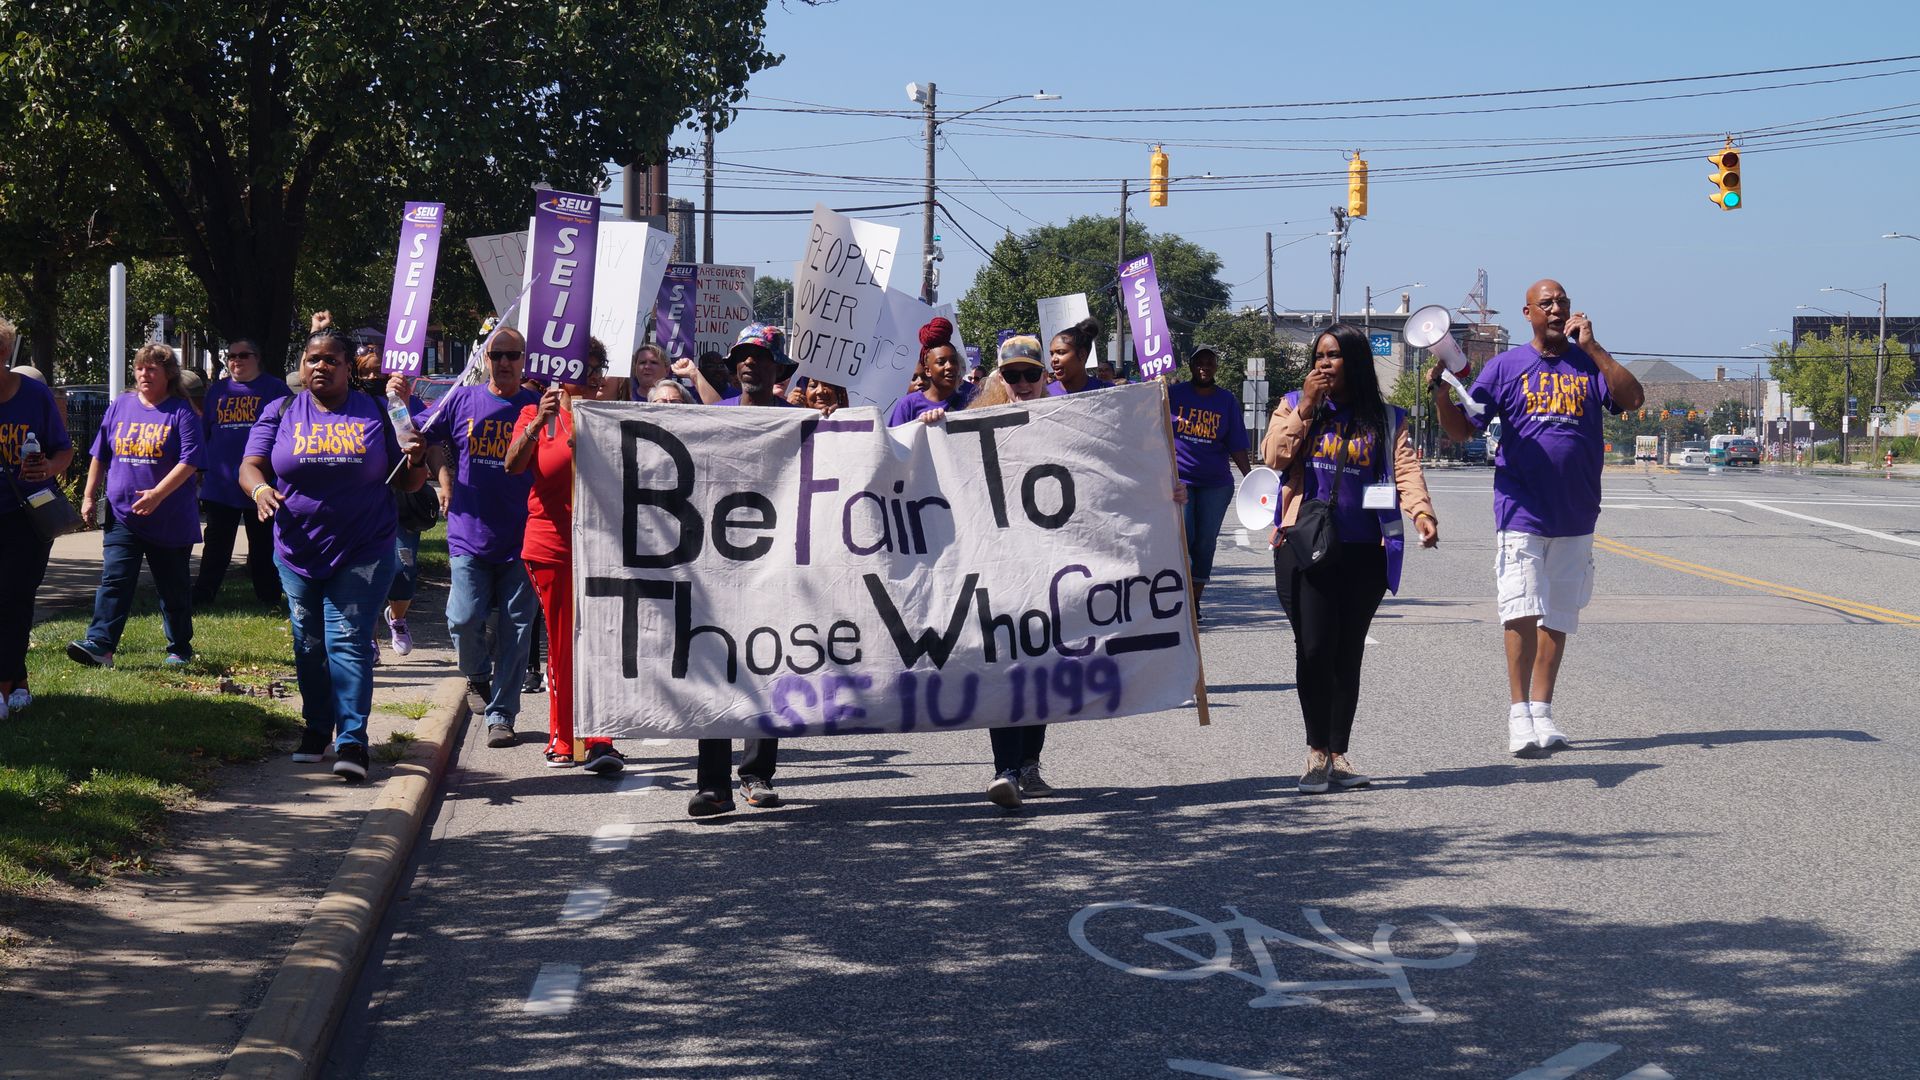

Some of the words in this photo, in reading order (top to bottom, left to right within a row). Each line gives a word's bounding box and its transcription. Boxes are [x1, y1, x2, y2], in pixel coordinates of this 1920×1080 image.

[416, 207, 438, 216] SEIU
[558, 197, 592, 211] SEIU
[599, 230, 629, 268] ity
[807, 224, 891, 288] PEOPLE
[671, 266, 693, 274] SEIU
[697, 266, 746, 279] AREGIVERS
[1129, 257, 1148, 272] SEIU
[395, 233, 427, 344] SEIU
[543, 227, 579, 349] SEIU
[716, 280, 745, 291] TRUST
[703, 293, 721, 303] THE
[801, 280, 854, 330] OVER
[666, 284, 685, 358] SEIU
[696, 304, 750, 321] EVELAND
[1134, 278, 1161, 357] SEIU
[385, 350, 420, 372] 1199
[529, 352, 584, 380] 1199
[1141, 354, 1173, 378] 1199
[1521, 373, 1529, 395] I
[1539, 372, 1588, 397] FIGHT
[216, 398, 222, 411] I
[227, 396, 262, 409] FIGHT
[1527, 392, 1585, 416] DEMONS
[217, 407, 256, 424] DEMONS
[1189, 408, 1222, 428] FIGHT
[0, 423, 29, 444] GHT
[115, 421, 124, 439] I
[127, 422, 171, 443] FIGHT
[293, 422, 303, 438] I
[312, 423, 366, 439] FIGHT
[466, 418, 474, 437] I
[483, 419, 513, 439] FIG
[1177, 418, 1217, 439] DEMONS
[115, 437, 164, 457] DEMONS
[293, 435, 367, 455] DEMONS
[620, 420, 777, 568] Be
[795, 420, 951, 566] Fair
[944, 410, 1076, 530] To
[585, 576, 863, 684] Those
[862, 573, 1051, 670] Who
[1049, 564, 1184, 657] Care
[757, 670, 980, 735] SEIU
[1010, 656, 1122, 722] 1199
